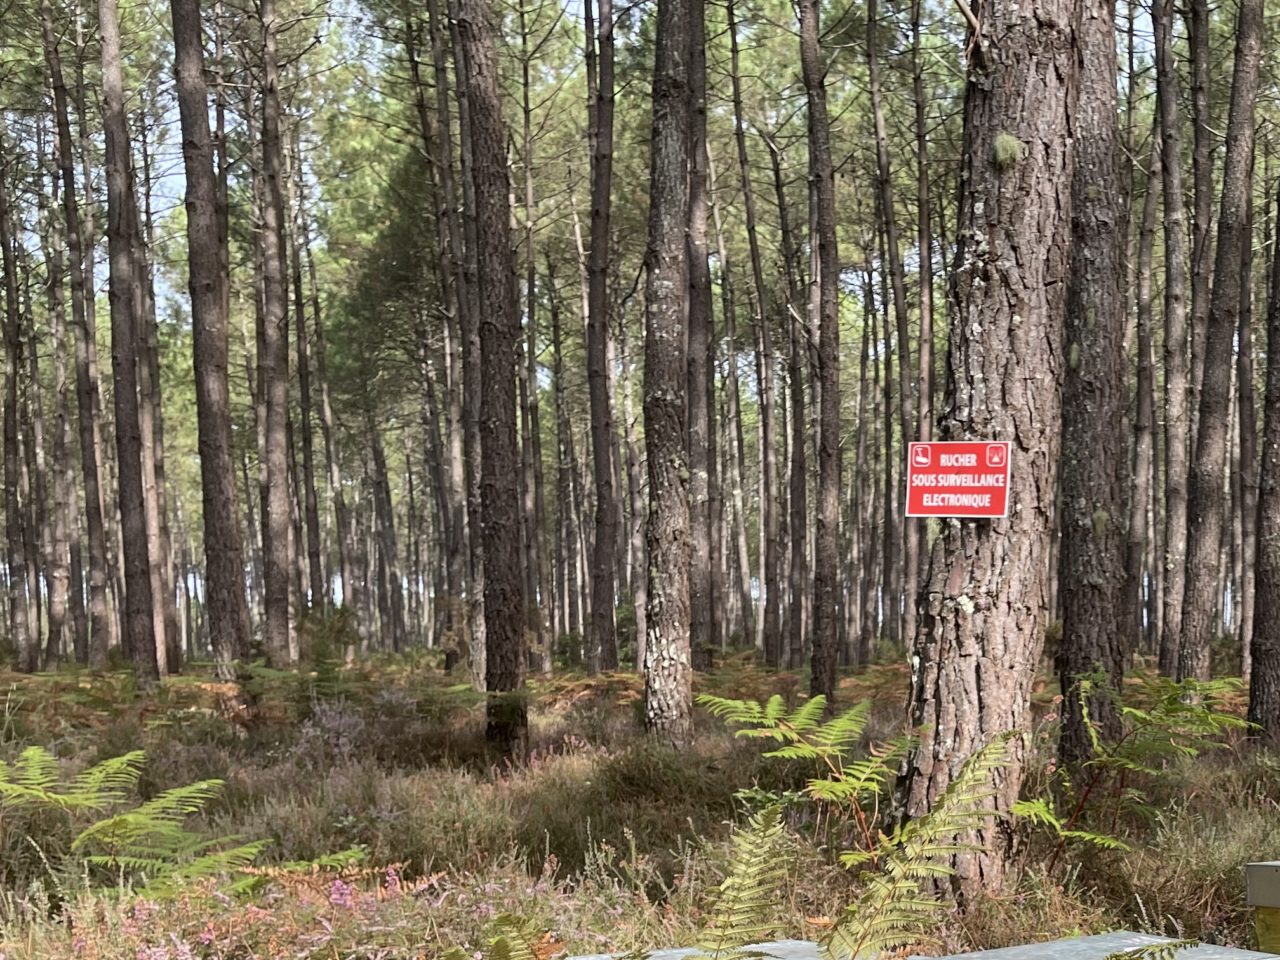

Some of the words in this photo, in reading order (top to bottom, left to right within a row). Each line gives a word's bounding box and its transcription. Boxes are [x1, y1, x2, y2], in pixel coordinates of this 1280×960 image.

[940, 454, 977, 466] RUCHER
[912, 474, 936, 486] SOUS
[938, 474, 1004, 486] SURVEILLANCE
[923, 494, 991, 508] ELECTRONIQUE
